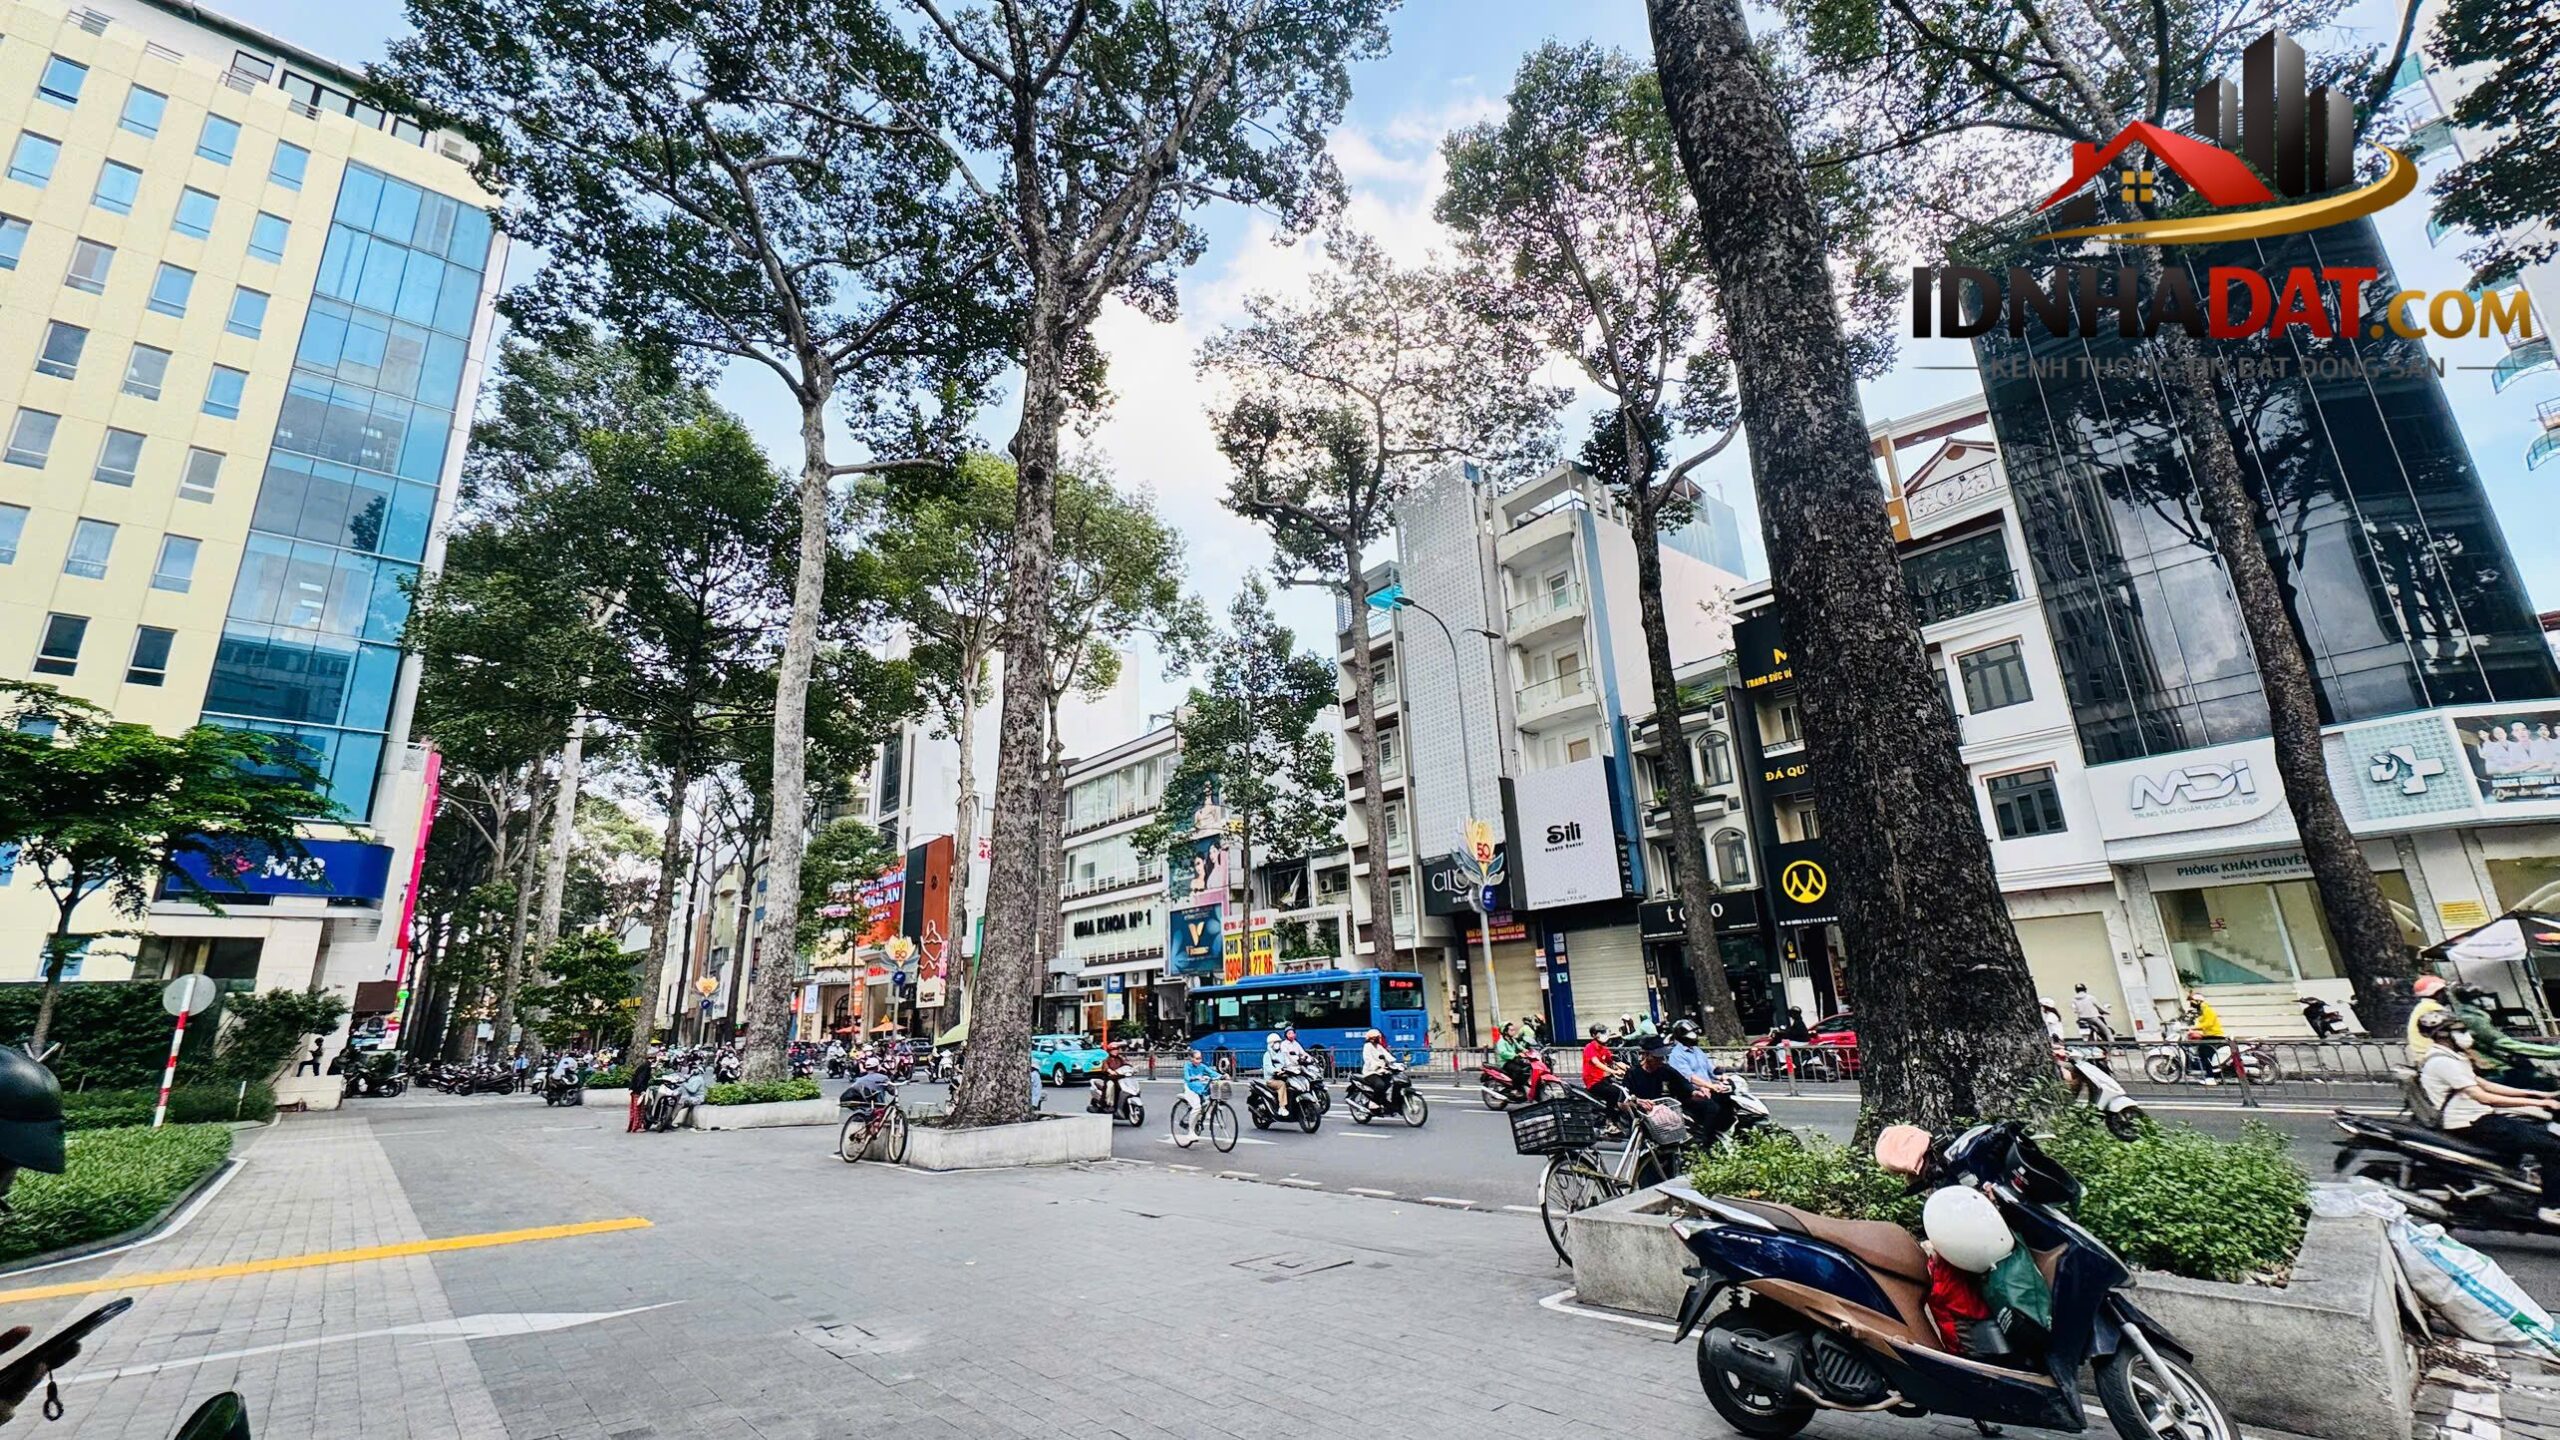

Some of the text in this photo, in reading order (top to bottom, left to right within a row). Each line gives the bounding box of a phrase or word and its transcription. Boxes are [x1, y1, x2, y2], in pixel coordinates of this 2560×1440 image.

[1787, 764, 1809, 778] QU
[2131, 759, 2256, 810] MDI
[1546, 821, 1581, 844] Sili
[2177, 863, 2219, 877] PHÒNG
[2221, 857, 2258, 873] KHÁM
[1097, 913, 1127, 934] KHOA
[895, 950, 907, 959] 50
